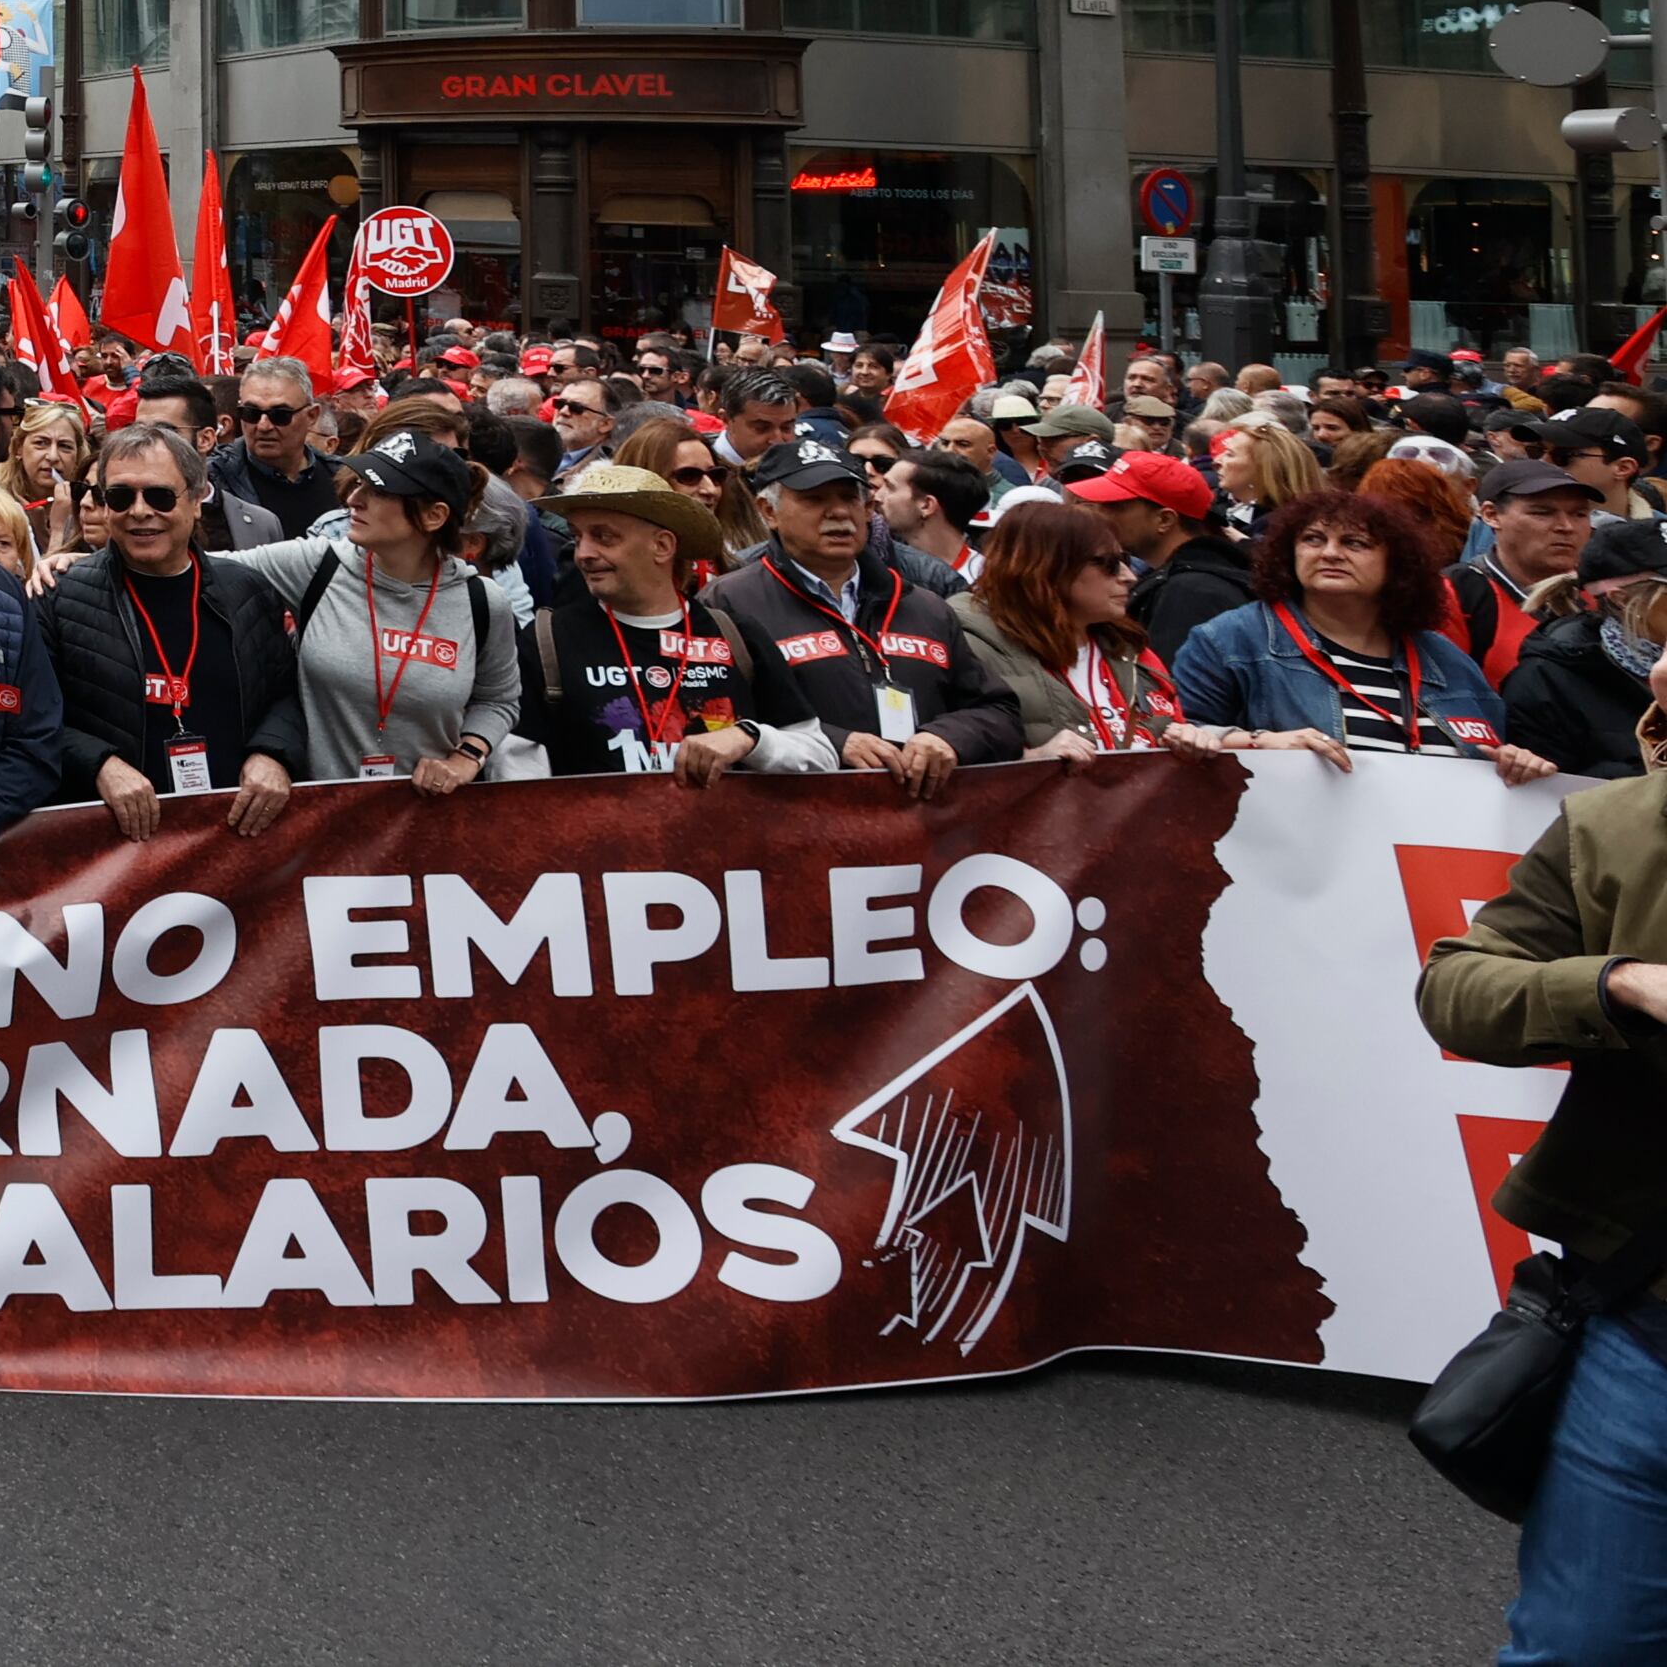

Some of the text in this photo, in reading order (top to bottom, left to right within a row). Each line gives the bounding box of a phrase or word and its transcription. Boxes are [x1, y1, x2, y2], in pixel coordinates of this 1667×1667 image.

[442, 73, 672, 98] GRAN CLAVEL
[850, 189, 891, 198] ABIERTO
[895, 189, 928, 199] TODOS
[931, 190, 949, 199] LOS
[367, 217, 435, 252] UGT
[385, 277, 428, 289] Madrid
[365, 469, 385, 486] UGT
[383, 632, 433, 658] UGT
[659, 633, 708, 658] UGT
[882, 637, 927, 655] UGT
[585, 666, 643, 686] UGT
[146, 679, 166, 698] GT
[1450, 721, 1488, 740] UGT
[303, 852, 1106, 1002] EMPLEO:
